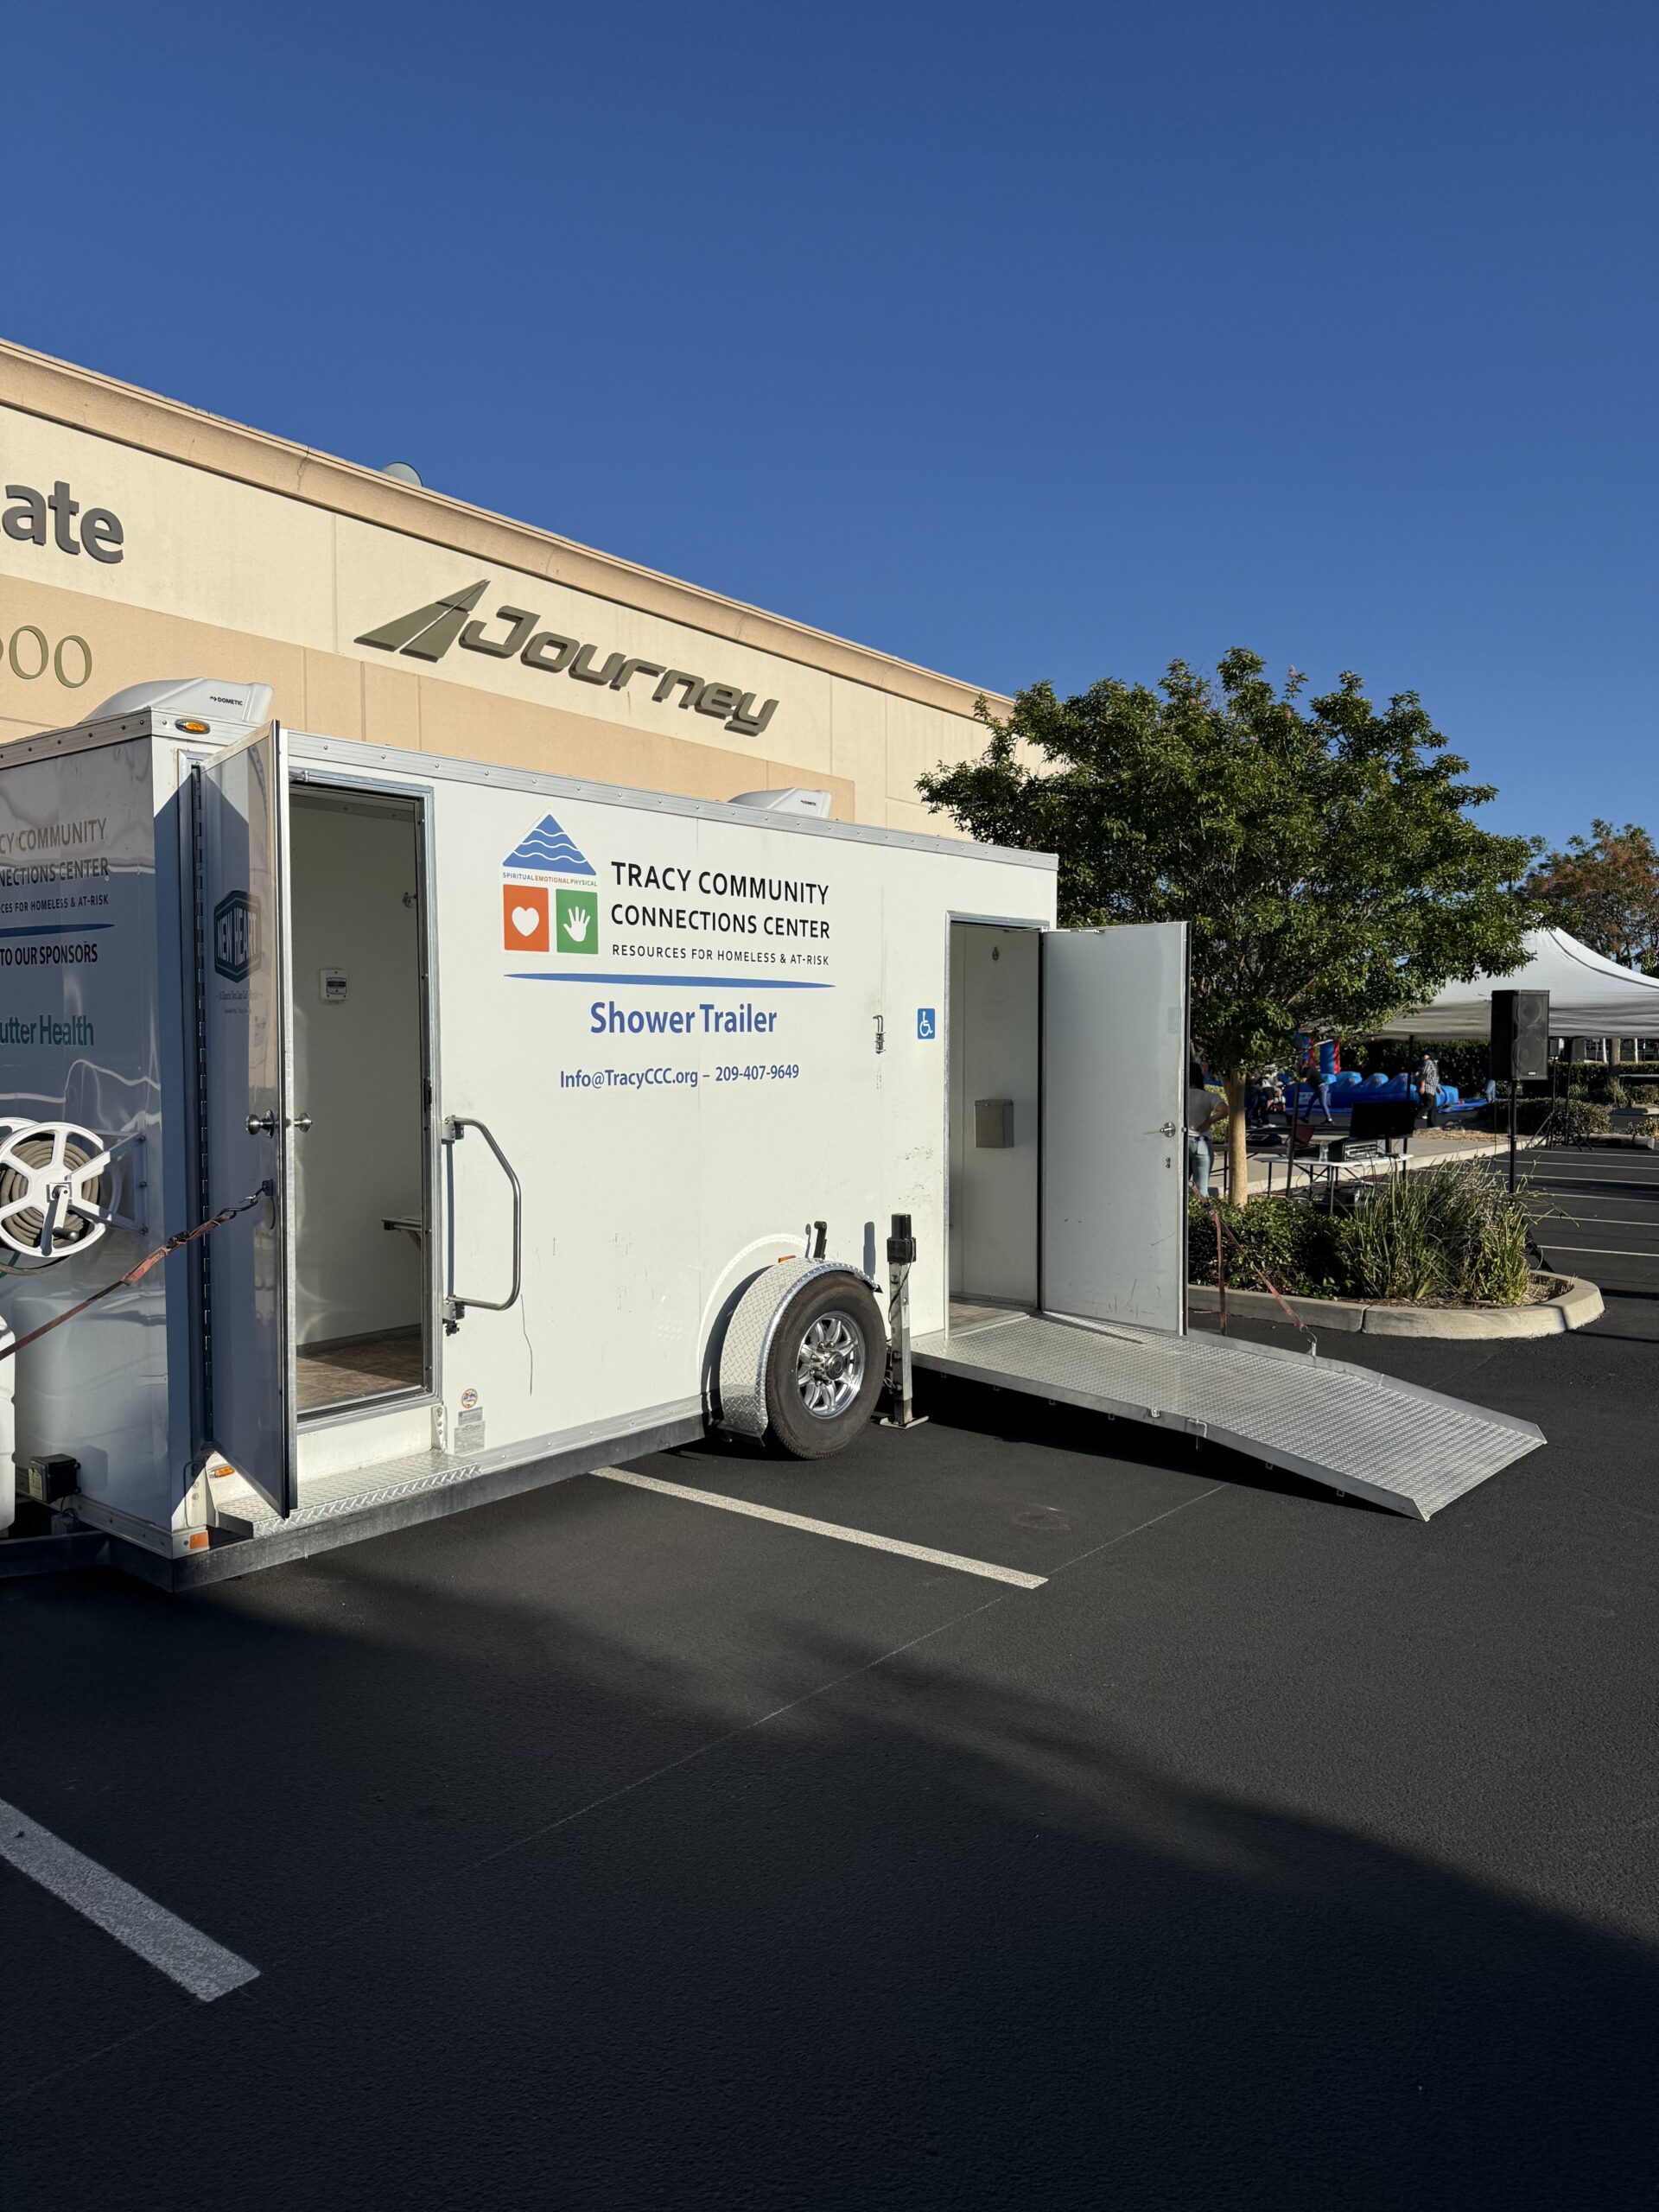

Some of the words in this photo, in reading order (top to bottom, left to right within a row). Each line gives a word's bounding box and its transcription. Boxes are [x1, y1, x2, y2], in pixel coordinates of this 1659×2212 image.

[1, 480, 124, 563] ate
[0, 625, 92, 688] 00
[458, 605, 779, 737] Journey
[218, 696, 243, 706] DOMETIC
[18, 817, 107, 851] COMMUNITY
[60, 857, 109, 880] CENTER
[503, 872, 534, 881] SPIRITUAL
[535, 875, 569, 884] EMOTIONAL
[611, 861, 691, 892] TRACY
[698, 871, 829, 905] COMMUNITY
[0, 902, 13, 913] CES
[16, 901, 29, 912] FOR
[31, 898, 68, 911] HOMELESS
[71, 897, 75, 907] &
[79, 894, 109, 906] AT-RISK
[611, 903, 757, 934] CONNECTIONS
[763, 916, 830, 939] CENTER
[0, 948, 12, 966] TO
[15, 947, 37, 965] OUR
[39, 943, 98, 964] SPONSORS
[612, 944, 686, 959] RESOURCES
[691, 948, 713, 960] FOR
[717, 950, 776, 963] HOMELESS
[780, 953, 786, 963] &
[790, 954, 830, 966] AT-RISK
[0, 1016, 36, 1045] utter
[39, 1014, 94, 1046] Health
[589, 1001, 696, 1034] Shower
[699, 1003, 778, 1033] Trailer
[560, 1067, 698, 1089] Info@TracyCCC.org
[715, 1064, 799, 1083] 209-407-9649
